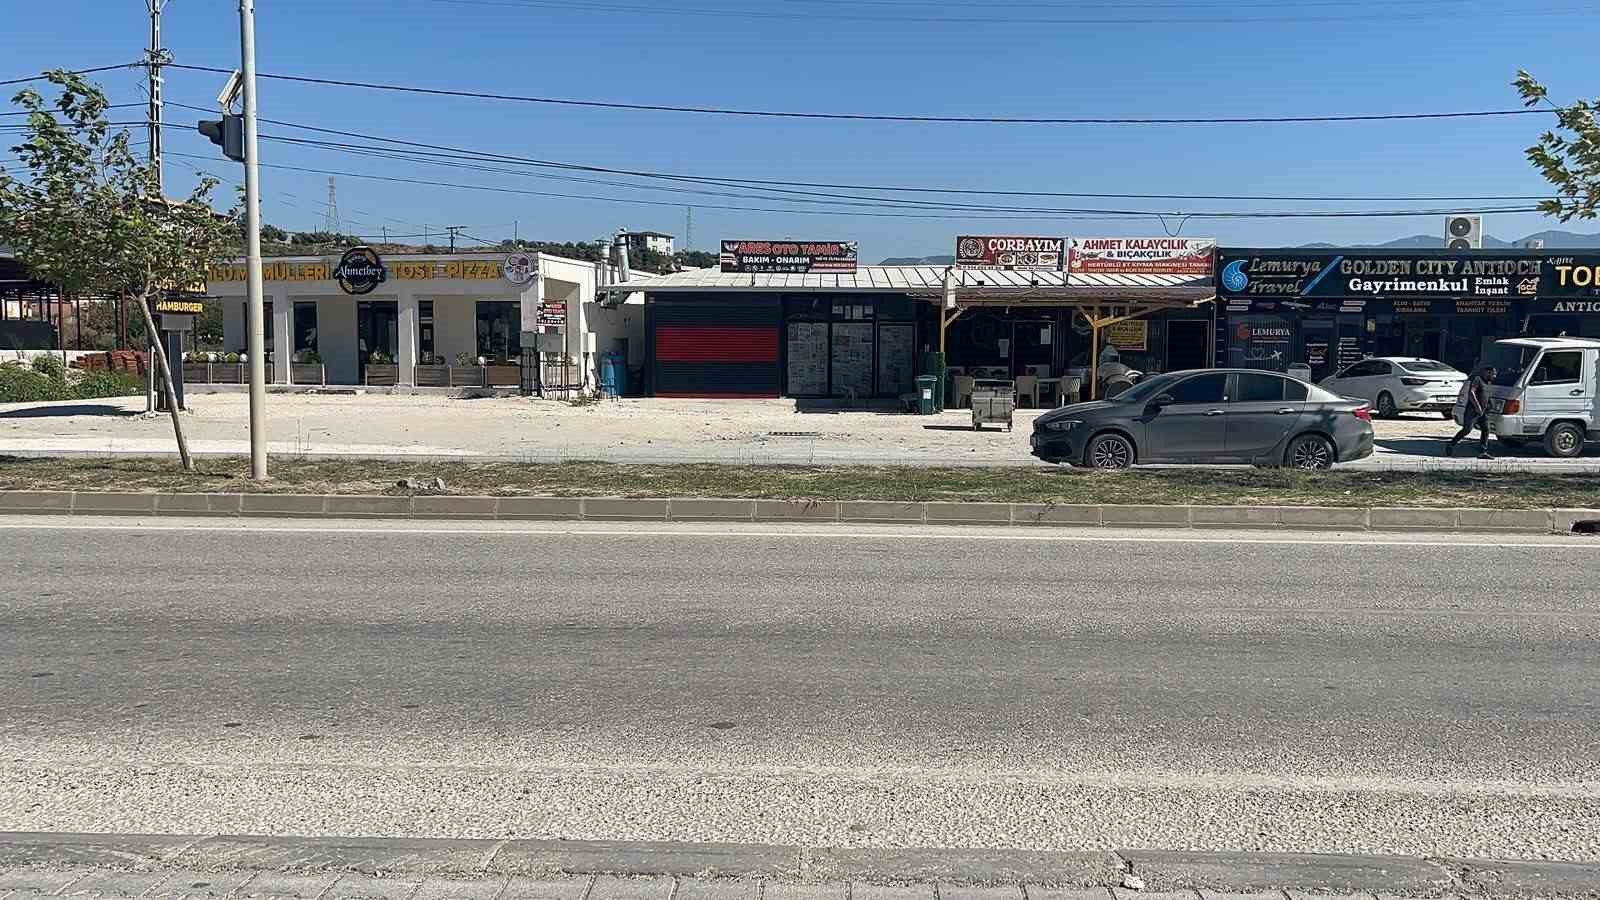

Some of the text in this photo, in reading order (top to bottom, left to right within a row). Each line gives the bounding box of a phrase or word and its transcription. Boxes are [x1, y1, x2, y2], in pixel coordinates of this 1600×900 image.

[738, 242, 840, 256] ARES OTO TAMİR
[988, 239, 1062, 254] ÇORBAYIM
[1083, 240, 1188, 250] AHMET KALAYCILIK
[743, 256, 770, 264] BAKIM
[776, 256, 810, 264] ONARIM
[1117, 251, 1172, 259] BIÇAKÇILIK
[1248, 257, 1321, 277] Lemurya
[1340, 260, 1411, 275] GOLDEN
[1416, 260, 1457, 275] CITY
[1461, 260, 1542, 275] ANTIOCH
[1248, 279, 1304, 294] Travel
[1349, 277, 1509, 293] Gayrimenkul Emlak
[156, 301, 203, 312] HAMBURGER
[1252, 328, 1290, 336] LEMURYA
